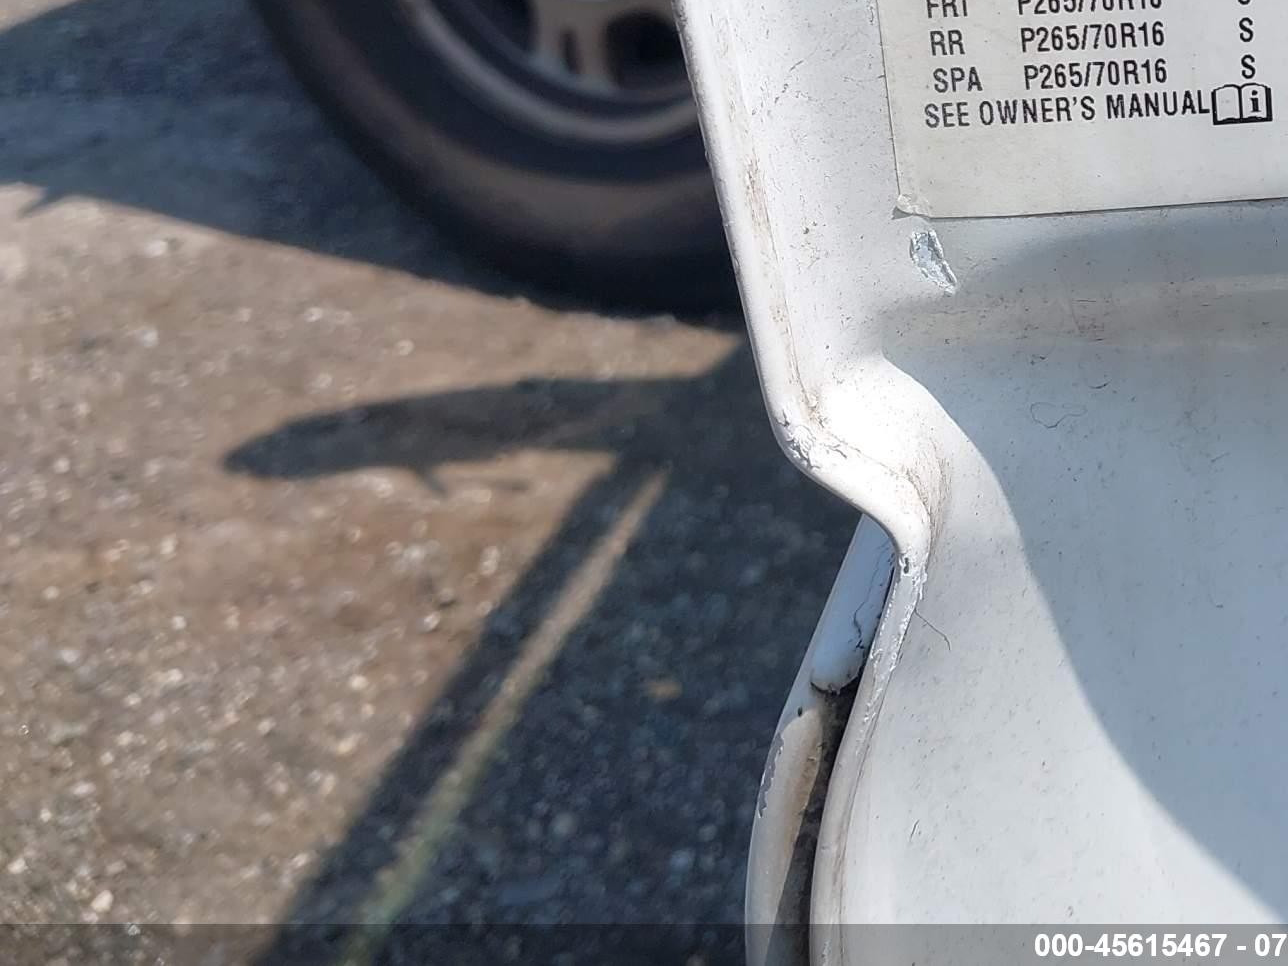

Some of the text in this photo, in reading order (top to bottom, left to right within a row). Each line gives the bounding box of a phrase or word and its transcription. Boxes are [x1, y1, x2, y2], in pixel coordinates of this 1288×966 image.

[1021, 21, 1164, 53] P265/70R16
[1239, 17, 1253, 42] S
[930, 30, 965, 56] RR
[1024, 58, 1167, 90] P265/70R16
[1241, 54, 1255, 79] S
[933, 67, 983, 93] SPA
[925, 102, 970, 128] SEE
[979, 96, 1095, 125] OWNER'S
[1106, 90, 1210, 119] MANUAL
